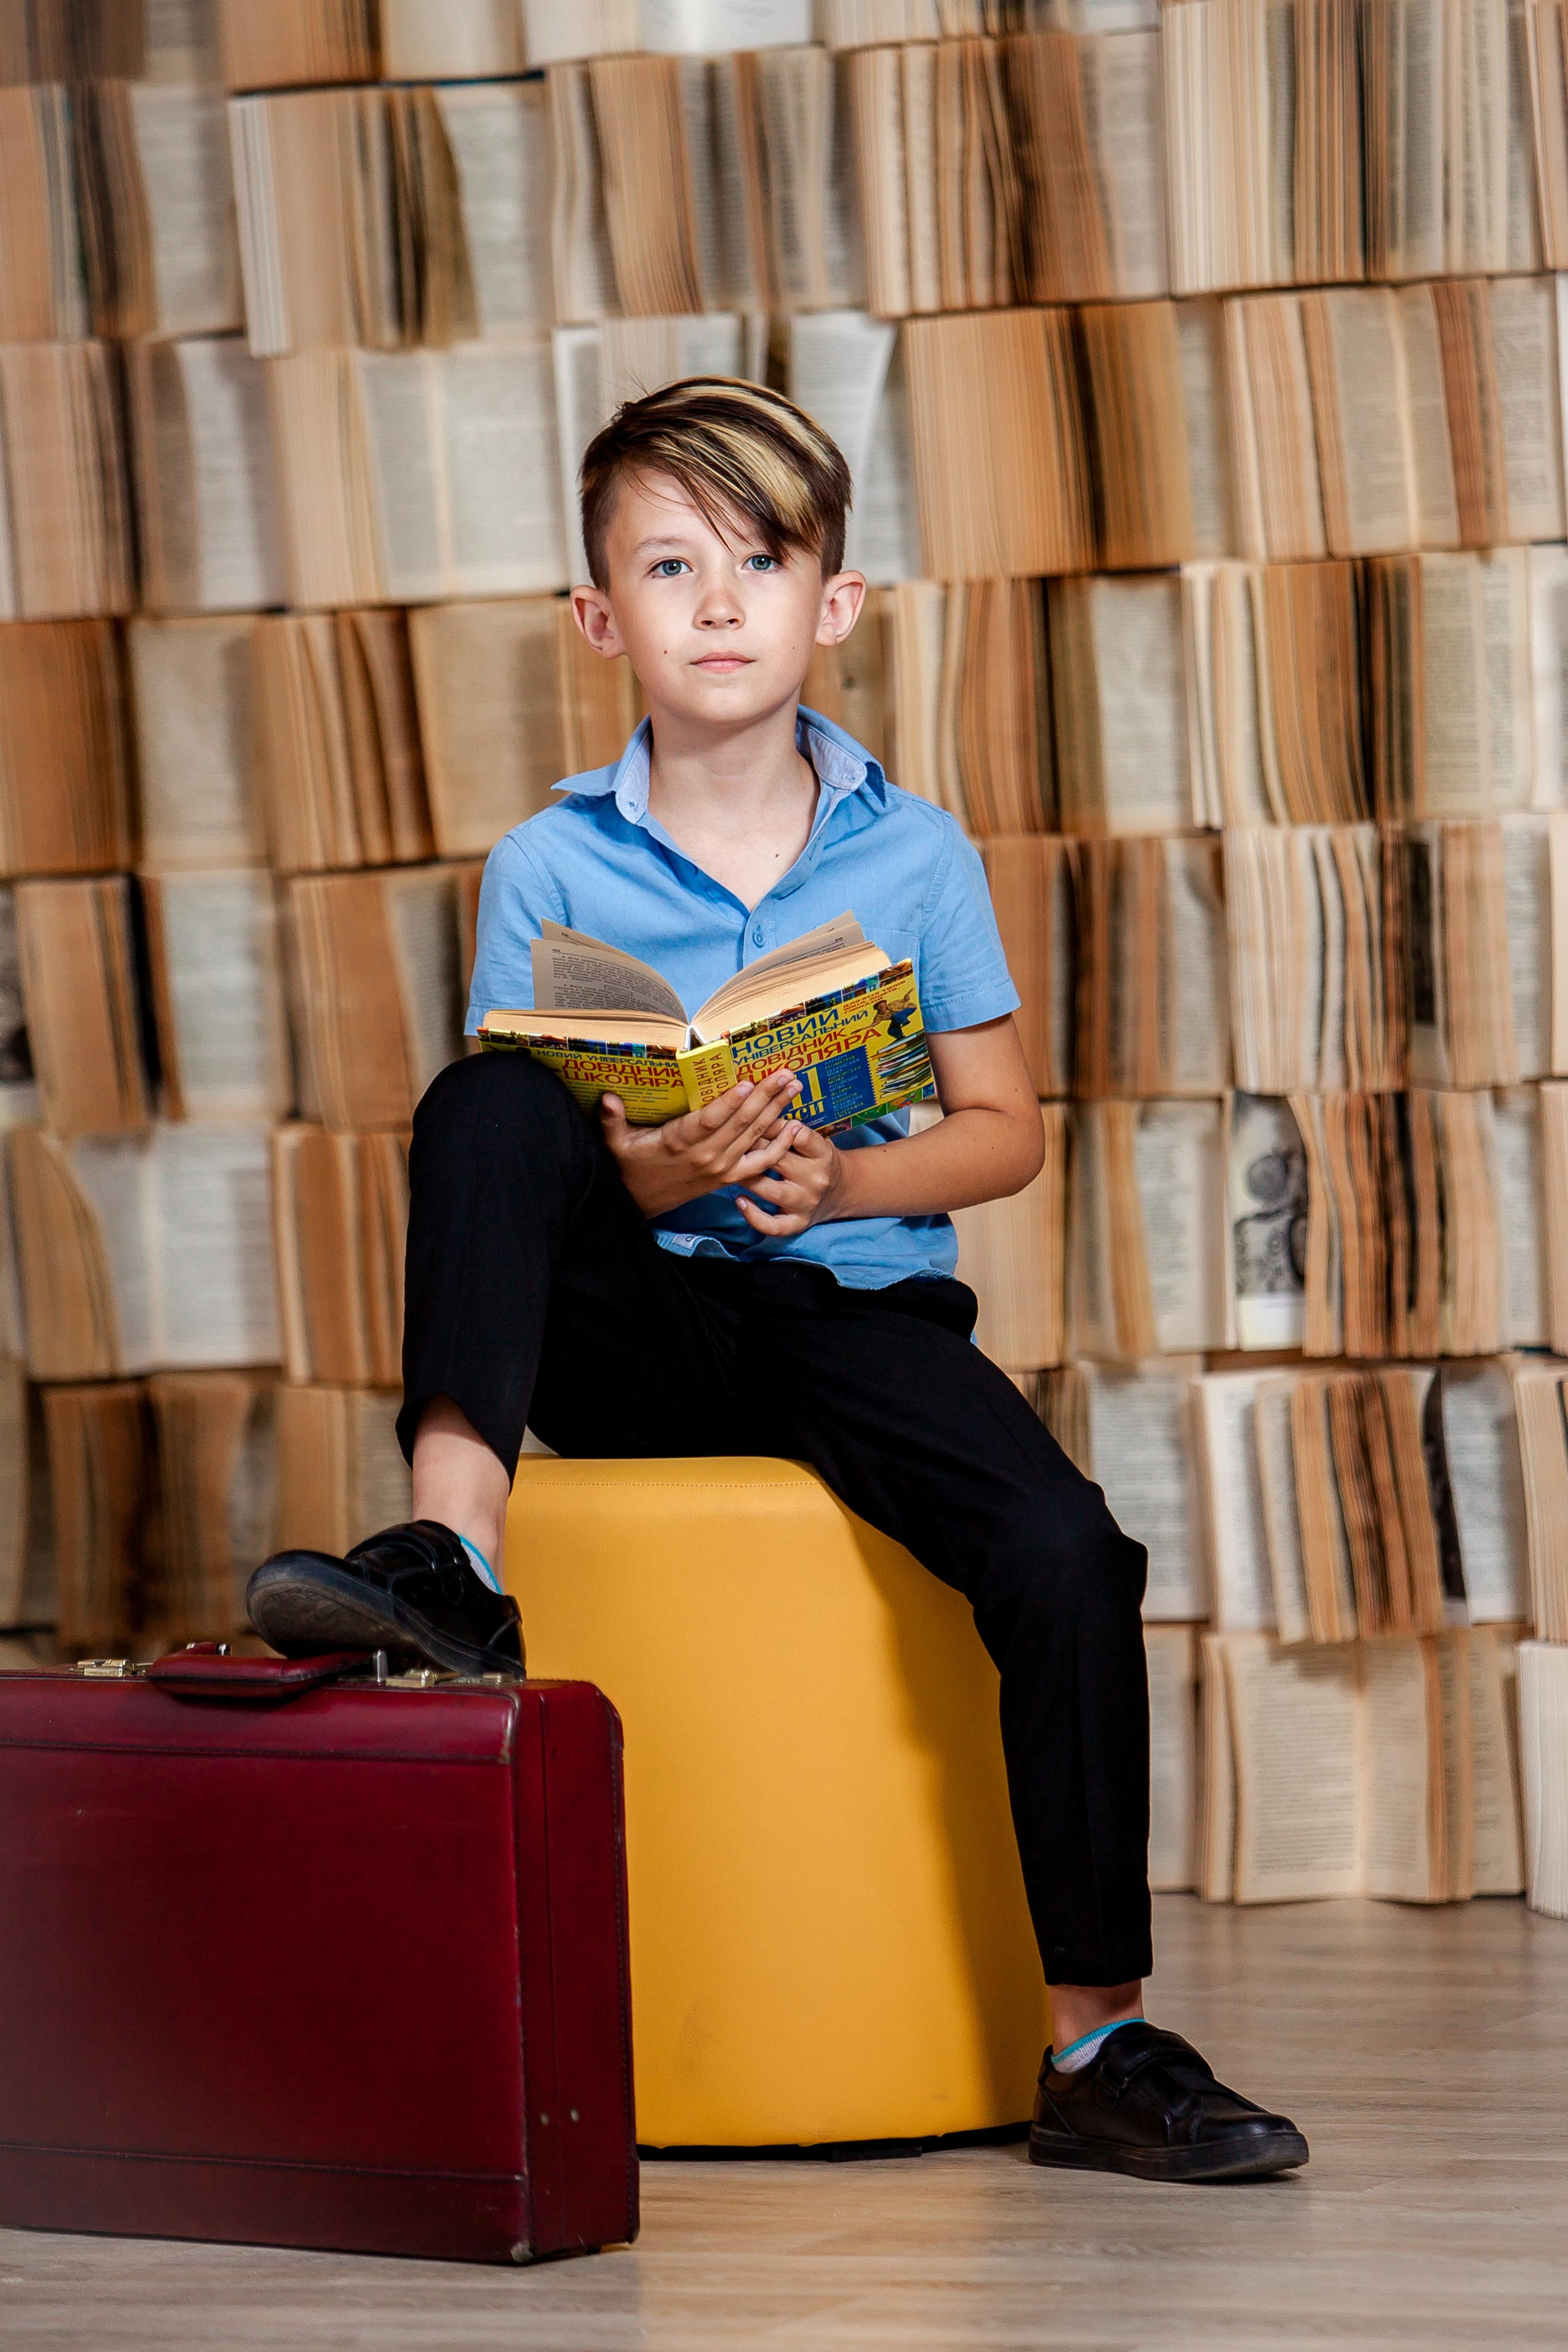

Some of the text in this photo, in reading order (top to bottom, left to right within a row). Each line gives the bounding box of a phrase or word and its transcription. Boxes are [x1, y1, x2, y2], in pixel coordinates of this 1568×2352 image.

[732, 1008, 839, 1058] НОВИЙ
[733, 1010, 869, 1066] УНІВЕРСАЛЬНИЙ
[737, 1028, 848, 1078] ДОВІДНИК
[537, 1049, 679, 1068] НОВИЙ УНІВЕРСАЛЬНИ
[562, 1059, 682, 1077] ДОВІДНИК
[564, 1070, 684, 1088] ШКОЛЯРА
[709, 1053, 730, 1096] КОЛЯРА
[693, 1058, 715, 1107] ОВІДНИК
